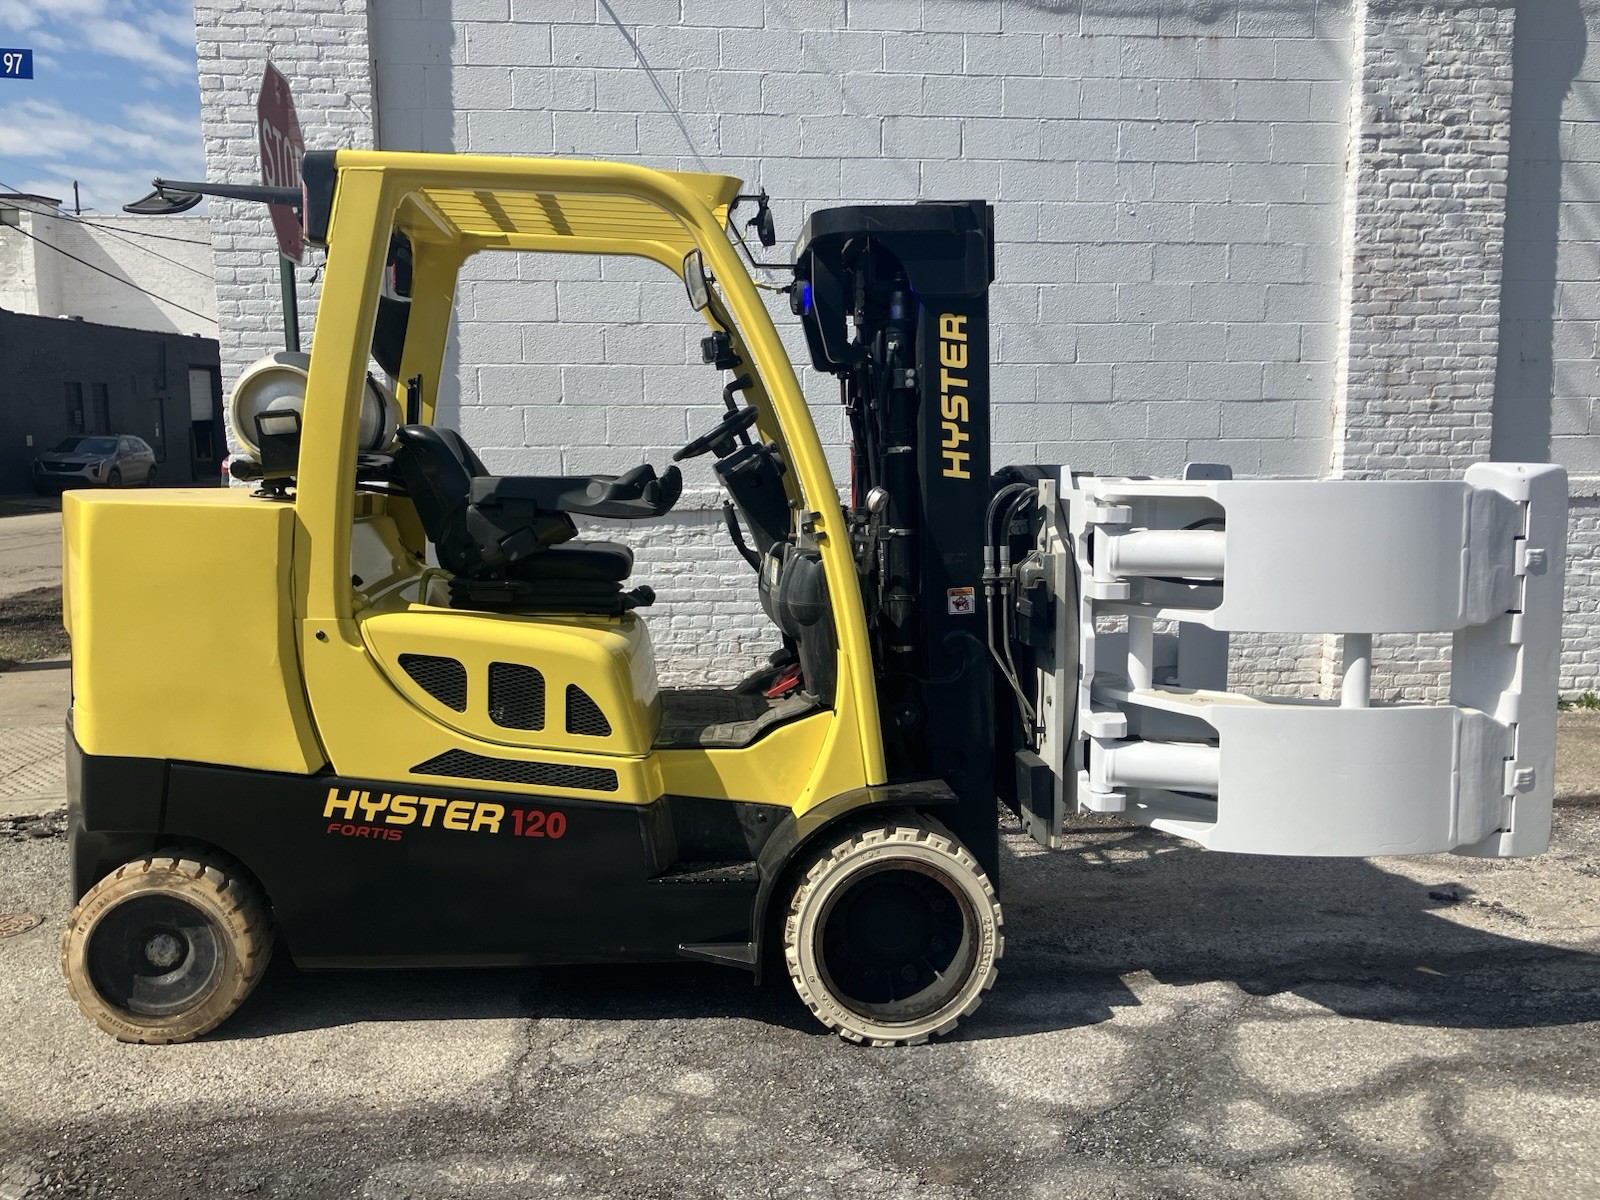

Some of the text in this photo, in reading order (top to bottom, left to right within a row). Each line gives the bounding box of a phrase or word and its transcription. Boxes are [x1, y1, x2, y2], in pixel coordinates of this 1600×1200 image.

[3, 52, 23, 75] 97
[939, 313, 971, 479] HYSTER
[322, 787, 567, 839] HYSTER 120
[327, 823, 403, 841] FORTIS
